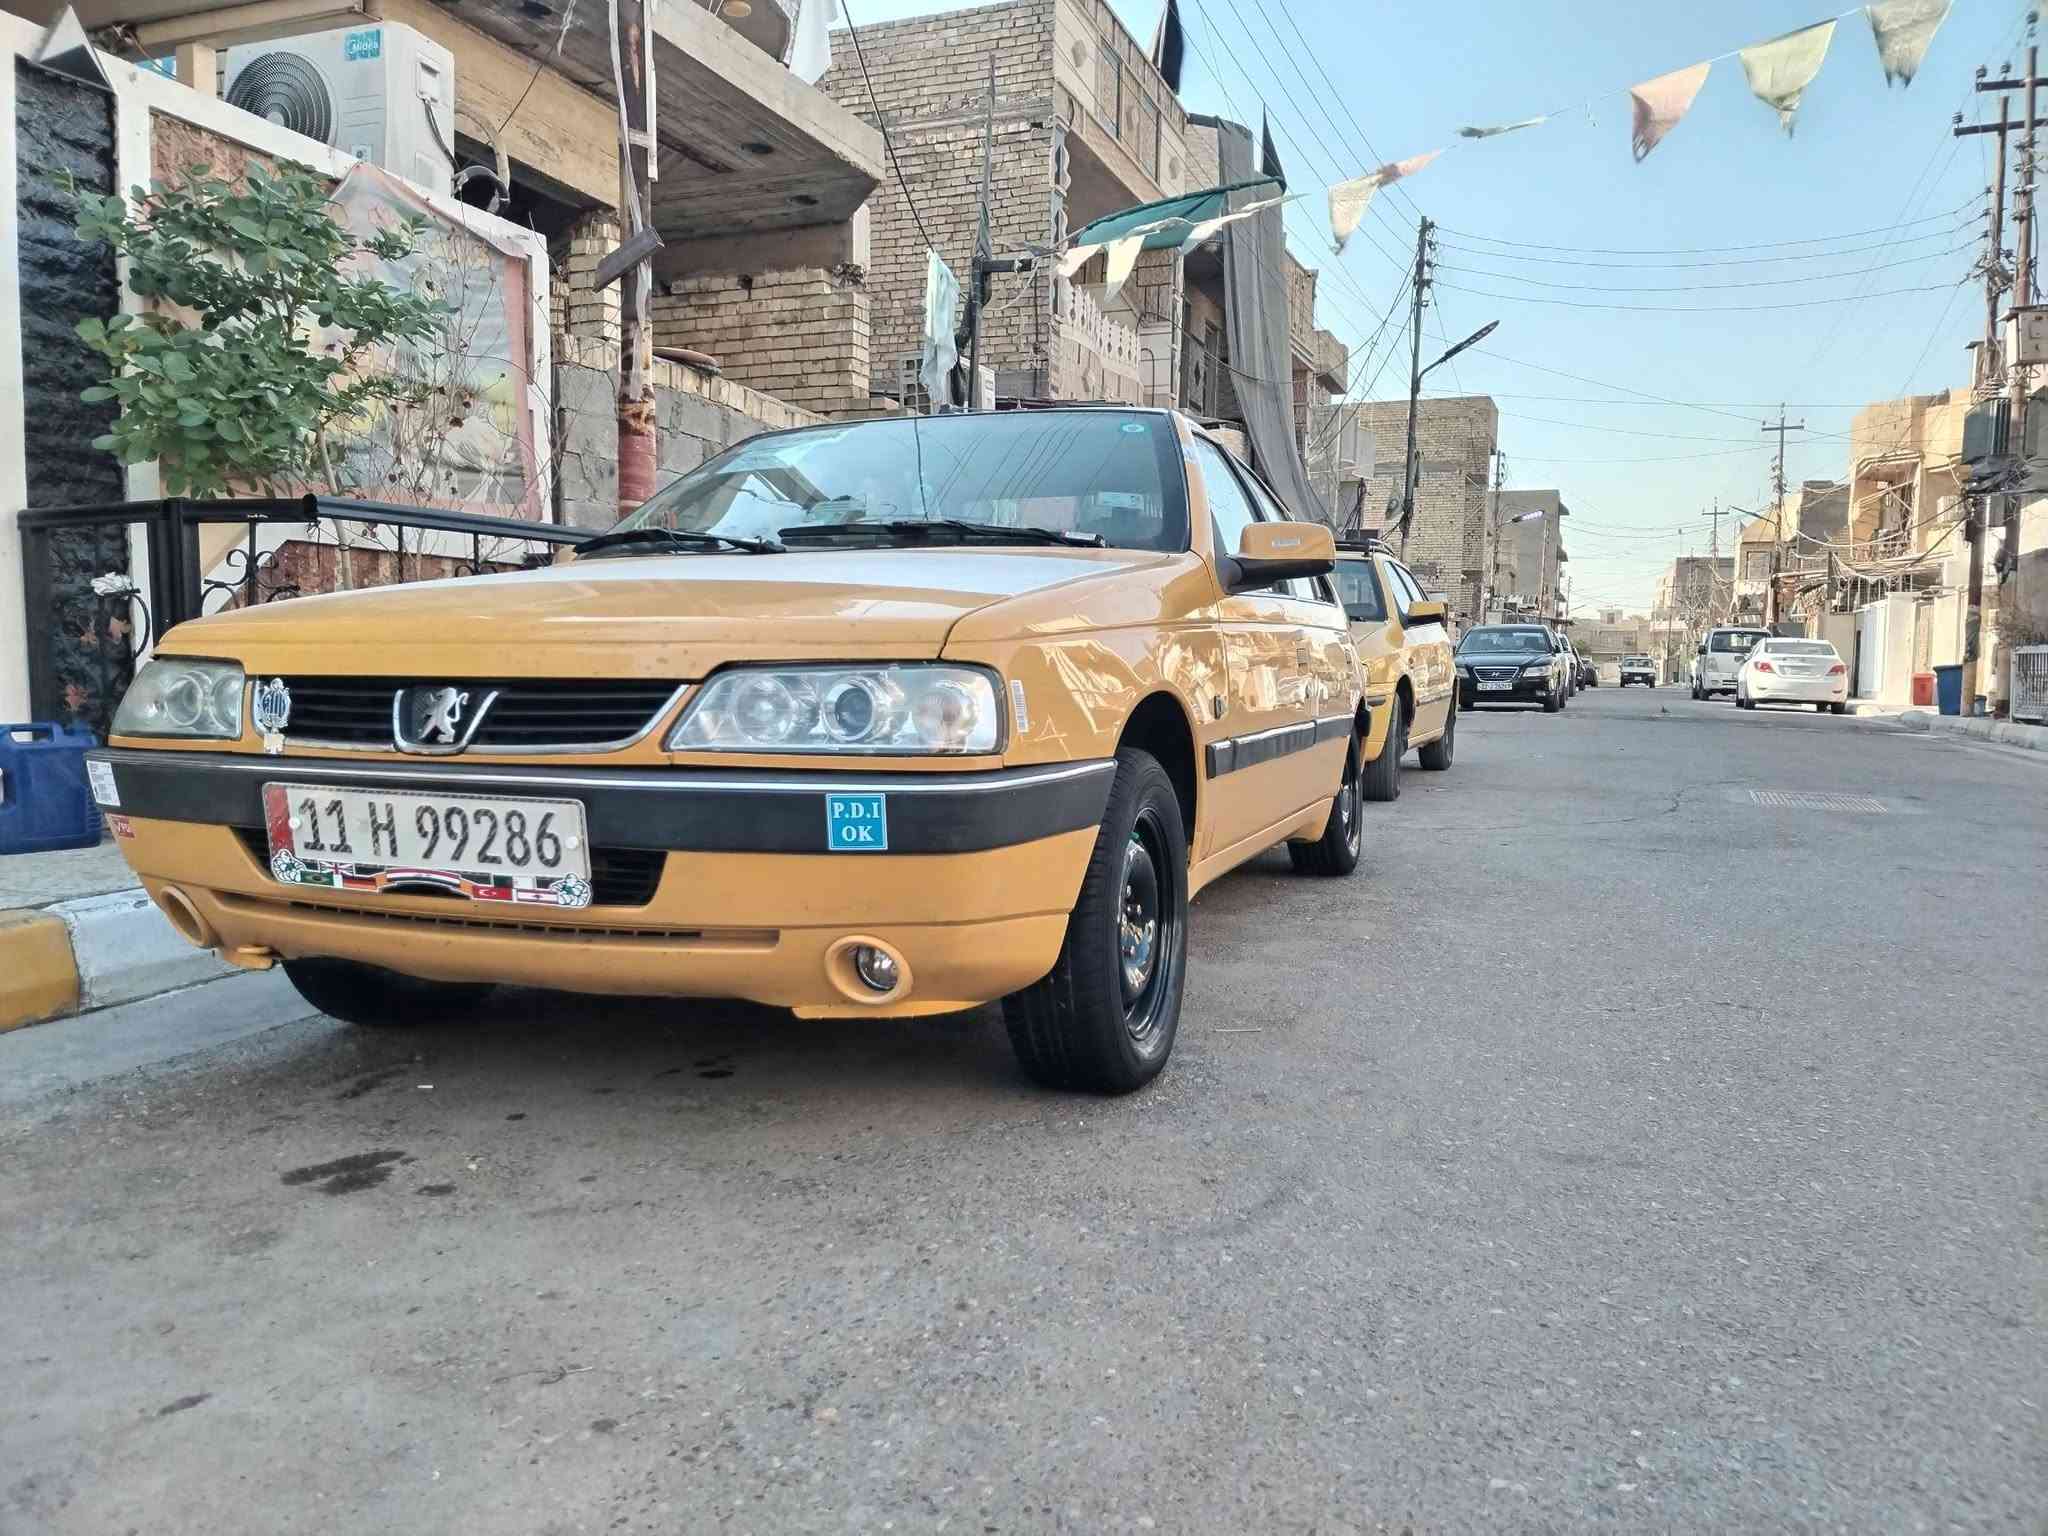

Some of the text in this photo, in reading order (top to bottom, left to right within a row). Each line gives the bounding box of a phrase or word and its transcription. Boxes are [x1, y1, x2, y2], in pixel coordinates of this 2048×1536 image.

[832, 801, 880, 819] P.D.I
[298, 797, 353, 854] 11
[367, 801, 398, 858] H
[415, 804, 563, 868] 99286
[841, 825, 874, 842] OK
